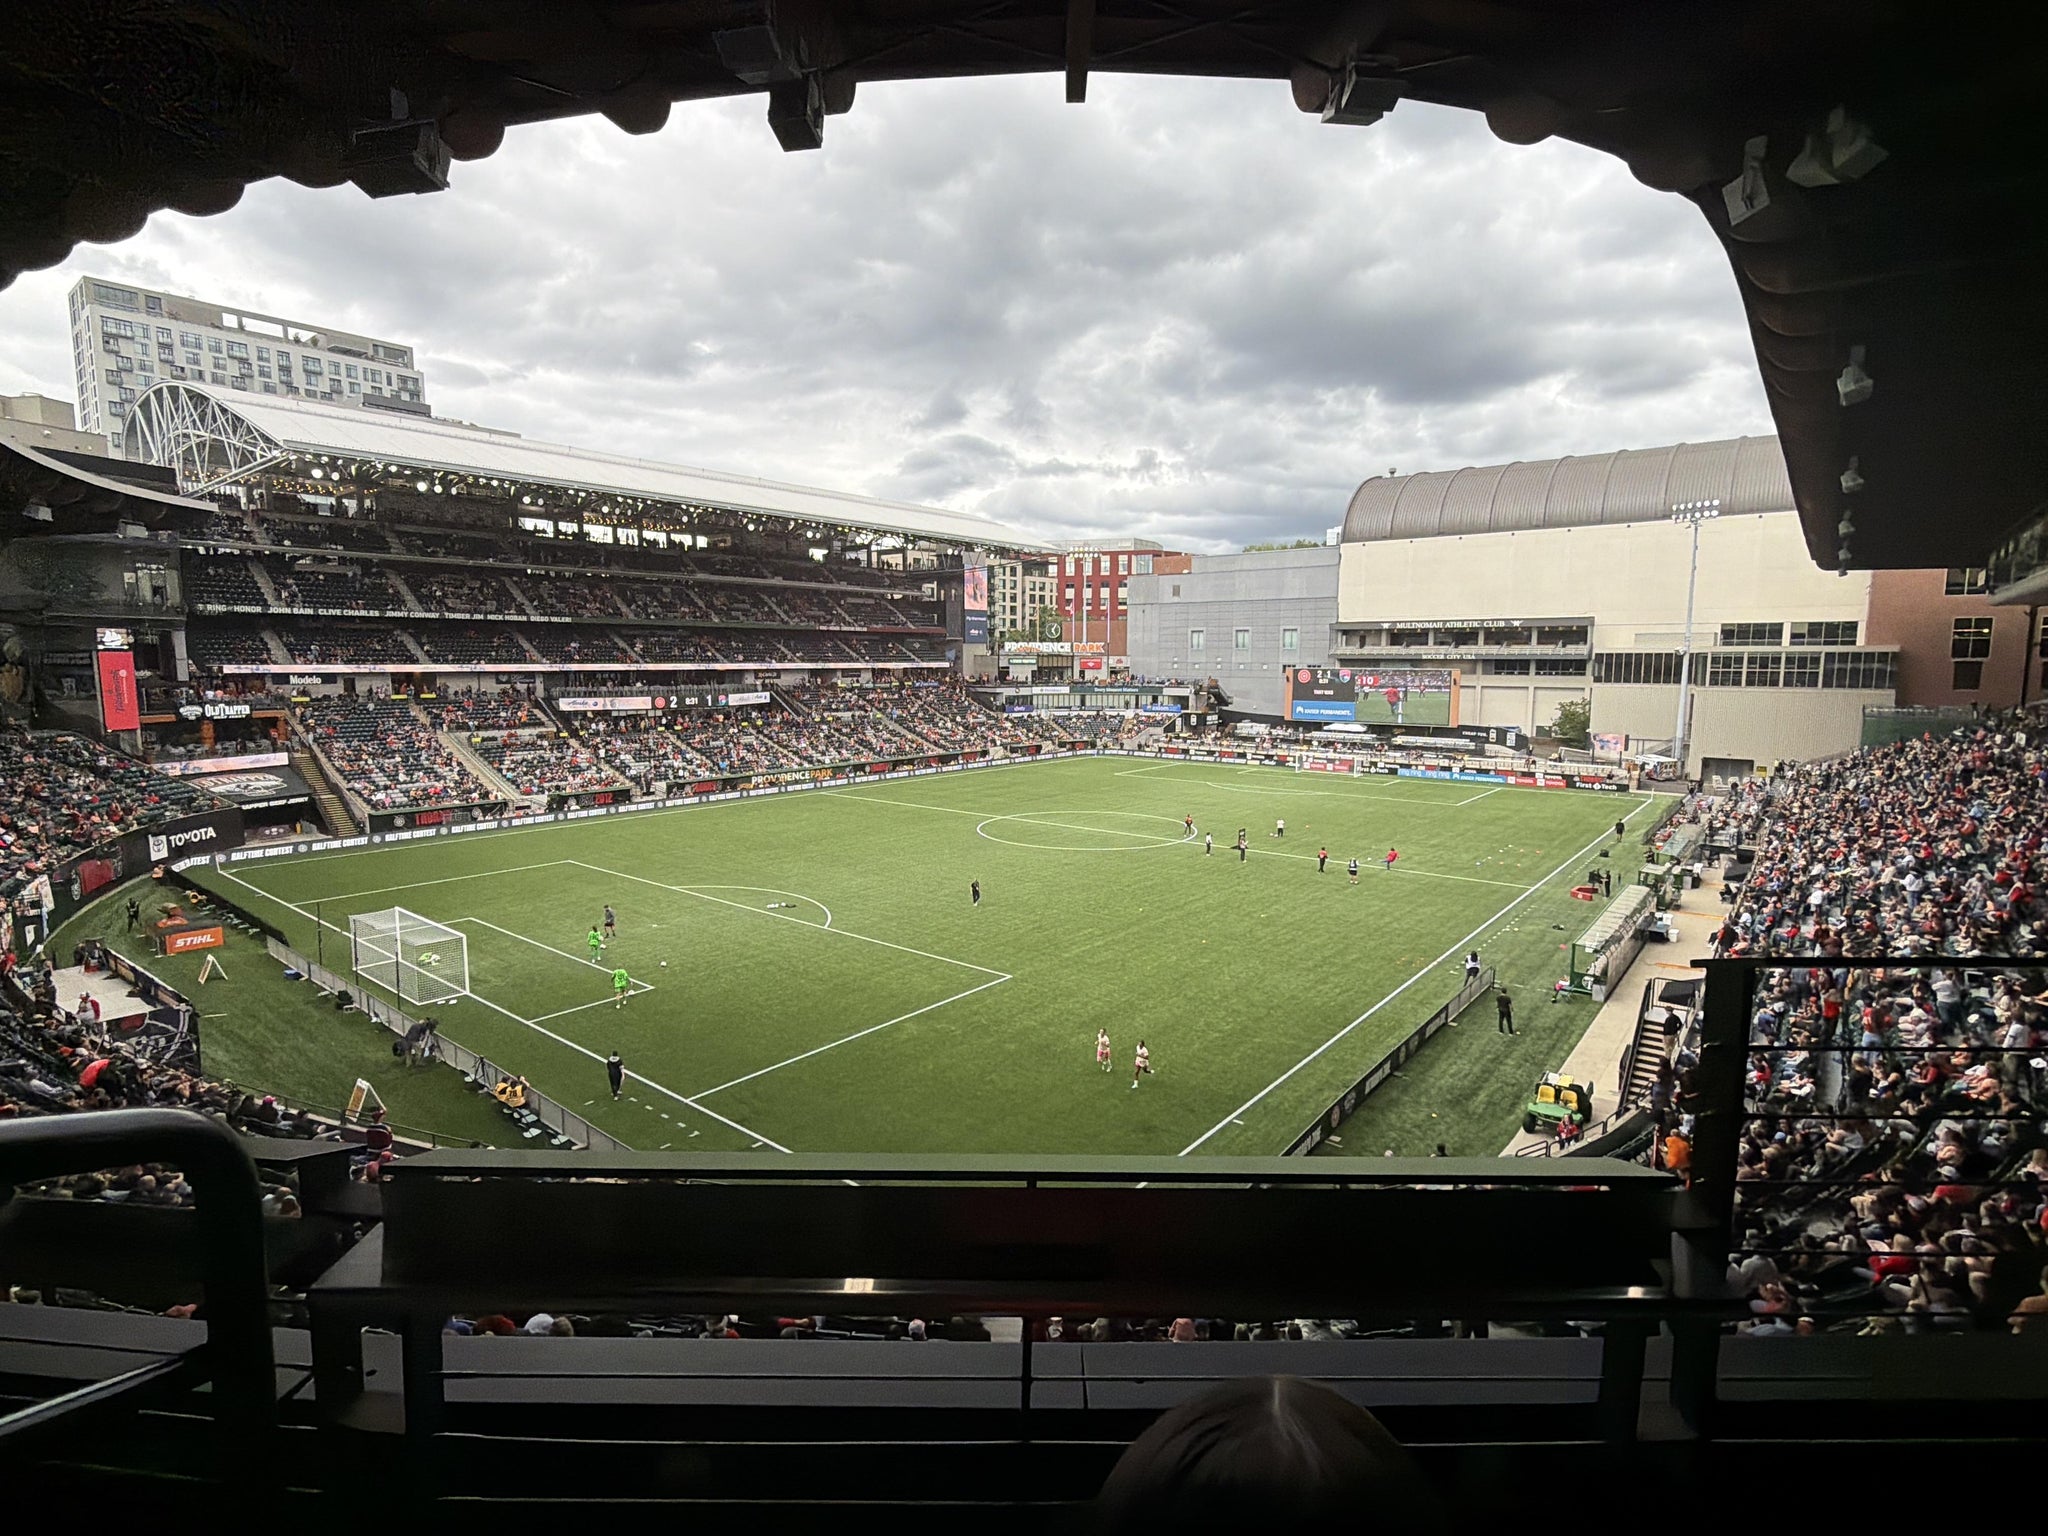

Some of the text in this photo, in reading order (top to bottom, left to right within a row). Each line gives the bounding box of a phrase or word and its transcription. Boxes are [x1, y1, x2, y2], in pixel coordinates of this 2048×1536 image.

[207, 604, 227, 612] RING
[293, 607, 314, 615] BAIN
[318, 608, 380, 617] CLIVE CHARLES
[1396, 621, 1442, 629] MULTNOMAH
[1004, 642, 1105, 653] PROVIDENCE PARK
[290, 675, 321, 684] Modelo
[670, 696, 678, 708] 2
[706, 695, 712, 706] 1
[205, 704, 220, 717] OLD
[220, 704, 250, 715] TRAPPER
[810, 768, 833, 778] PARK
[169, 827, 216, 848] TOYOTA
[342, 837, 369, 847] CONTEST
[265, 846, 294, 857] CONTEST
[175, 934, 215, 948] STIHL
